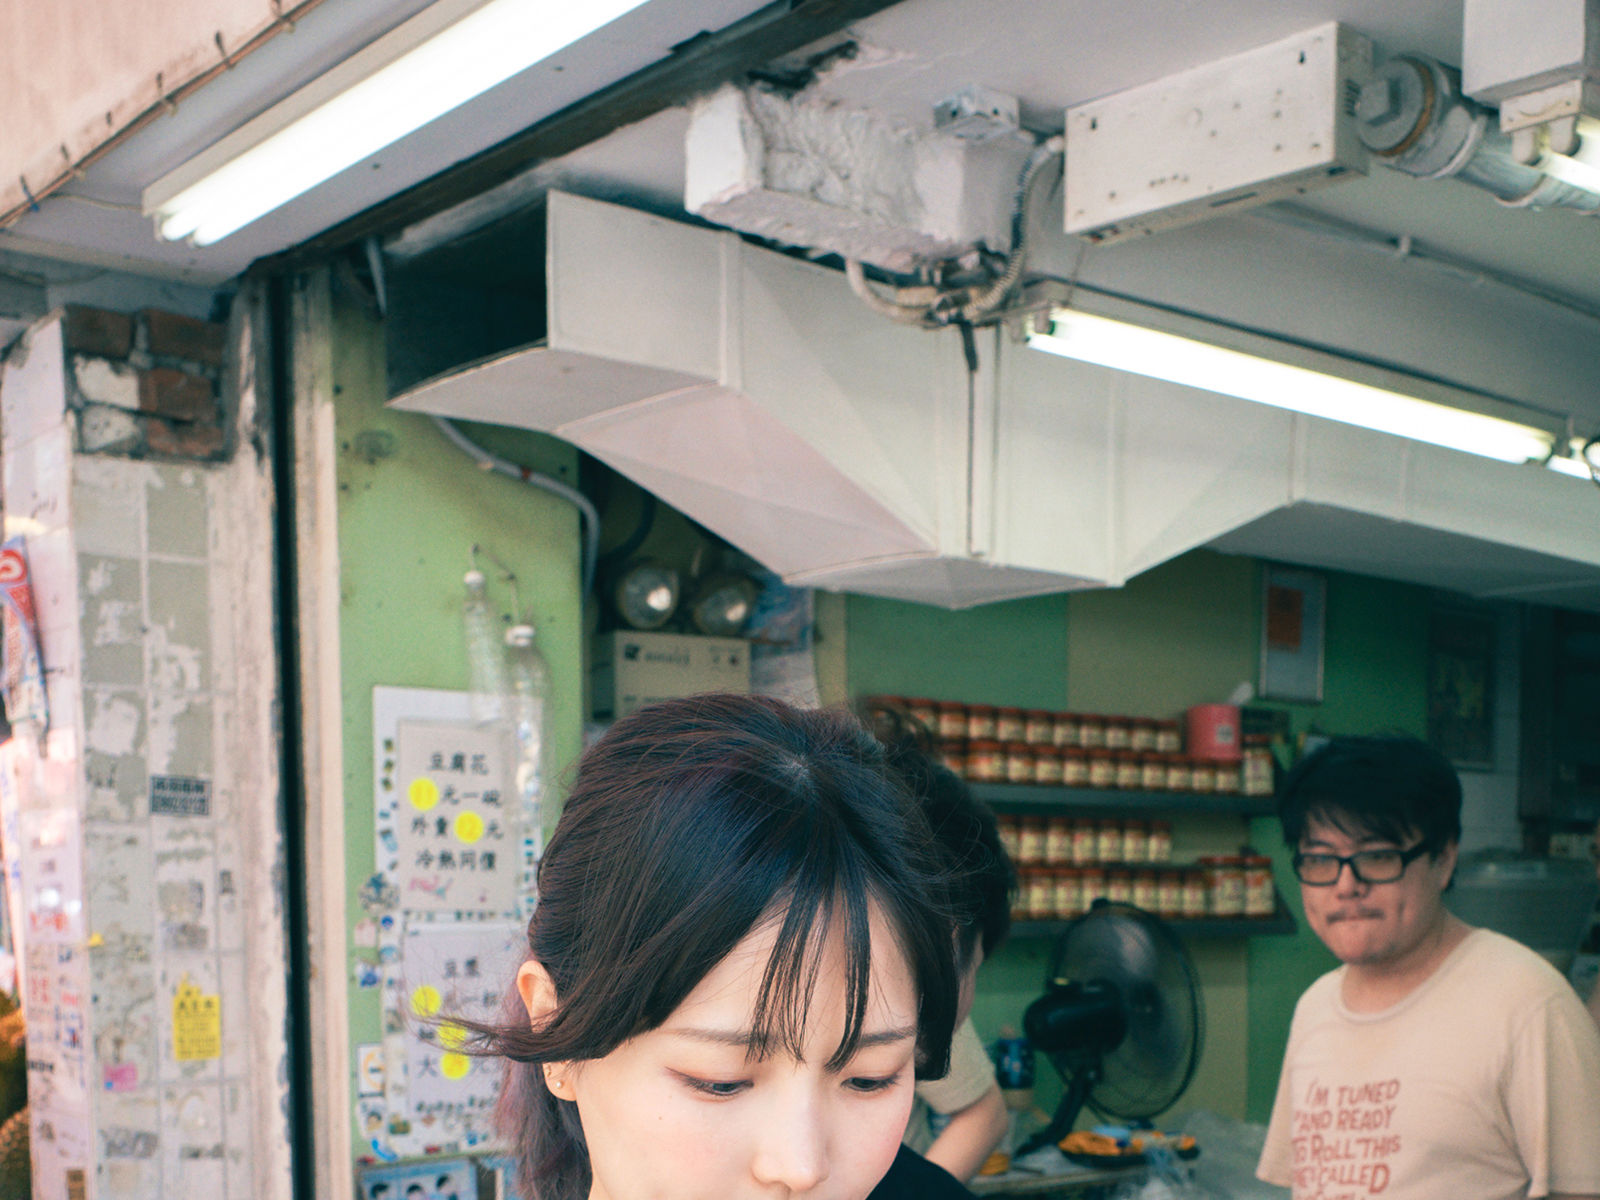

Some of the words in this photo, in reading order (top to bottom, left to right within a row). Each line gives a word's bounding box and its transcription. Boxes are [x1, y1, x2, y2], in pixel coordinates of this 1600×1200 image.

[1338, 1078, 1401, 1106] TUNED
[1336, 1105, 1397, 1131] READY
[1356, 1134, 1402, 1159] THIS
